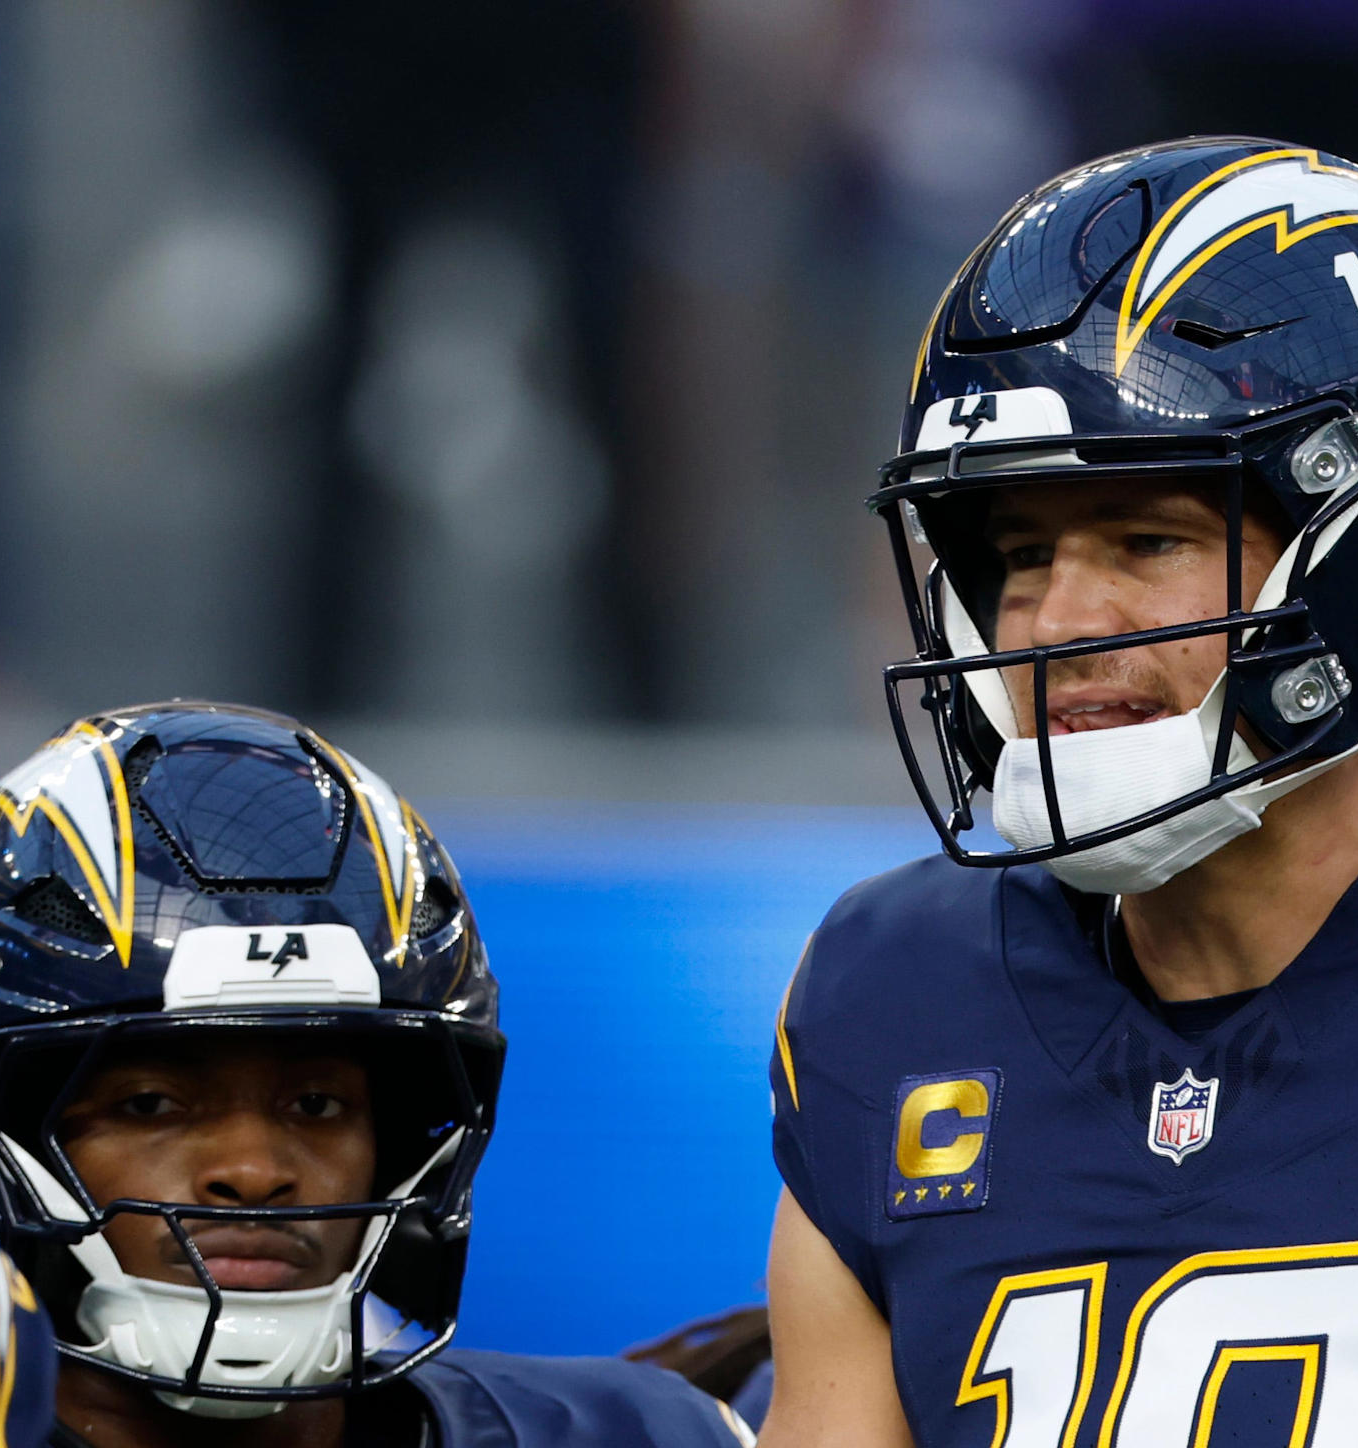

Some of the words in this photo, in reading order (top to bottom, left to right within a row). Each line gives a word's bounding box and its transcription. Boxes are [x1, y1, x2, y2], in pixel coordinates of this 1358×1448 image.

[949, 394, 997, 441] LA
[246, 932, 309, 978] LA
[895, 1078, 990, 1180] C
[1158, 1112, 1201, 1147] NFL
